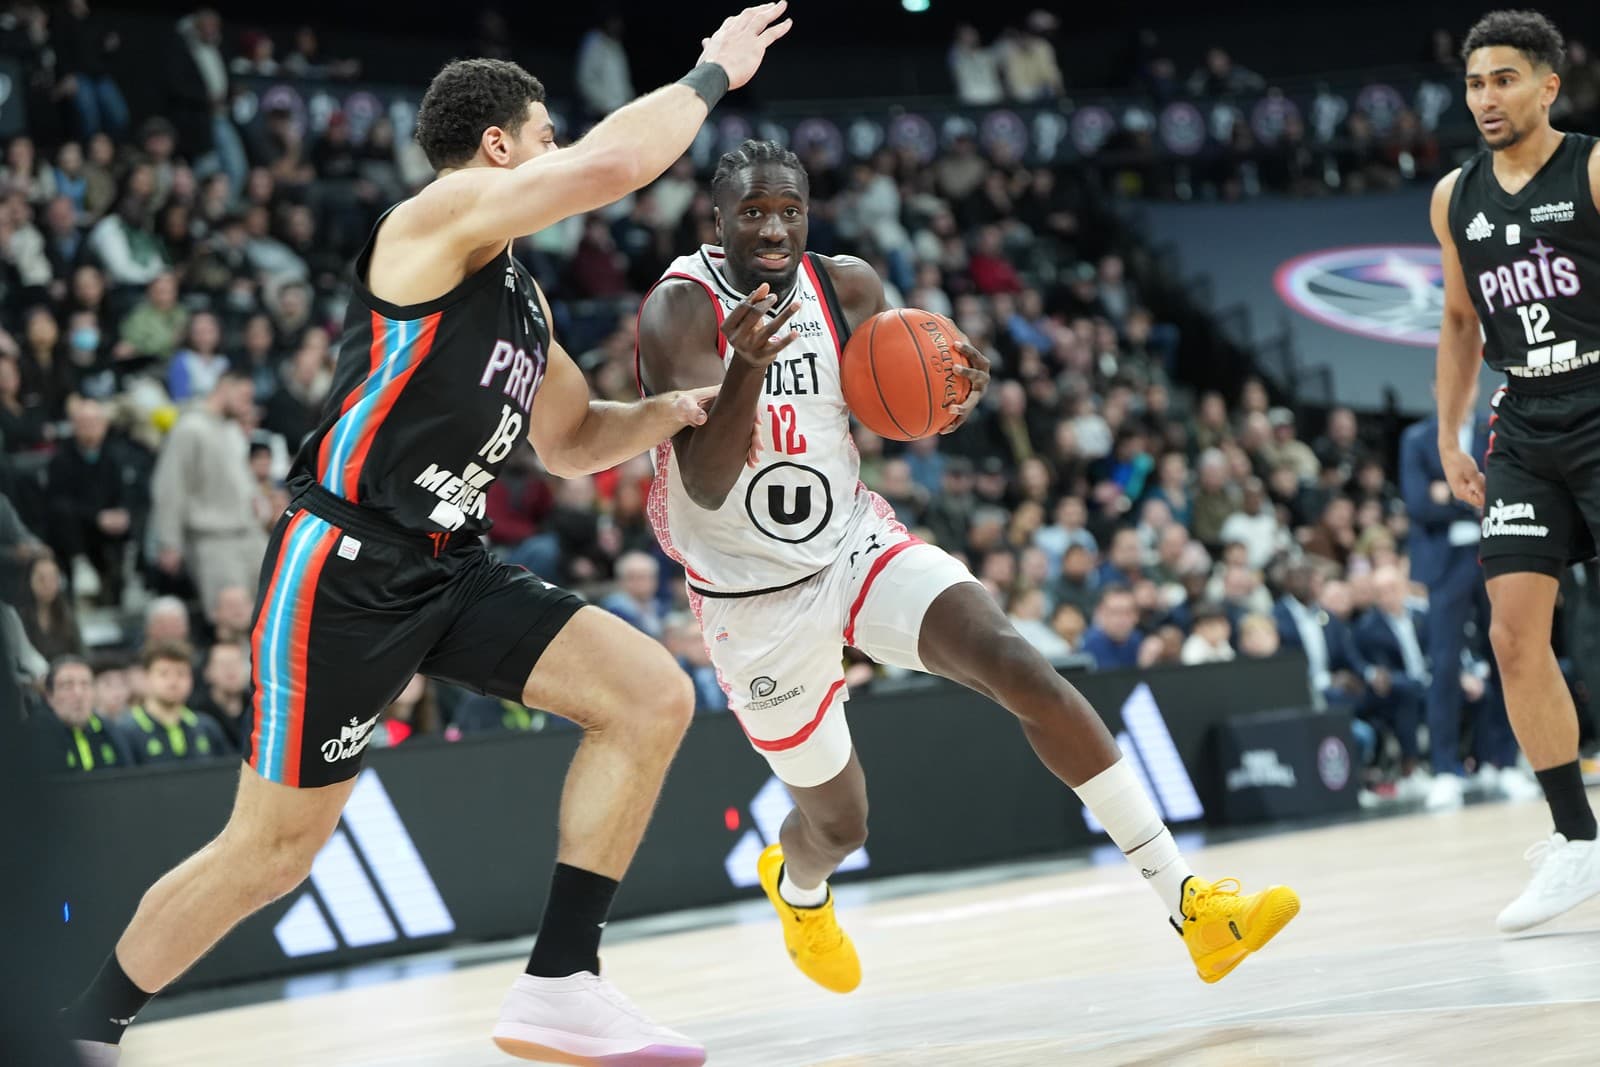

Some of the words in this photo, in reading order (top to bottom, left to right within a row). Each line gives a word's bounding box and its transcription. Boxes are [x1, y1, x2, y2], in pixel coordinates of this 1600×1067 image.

[1479, 239, 1581, 314] PARIS
[1516, 303, 1556, 345] 12
[480, 340, 544, 413] PARI
[920, 321, 957, 408] SPALDING
[478, 404, 522, 464] 18
[767, 404, 807, 455] 12
[768, 485, 811, 525] U
